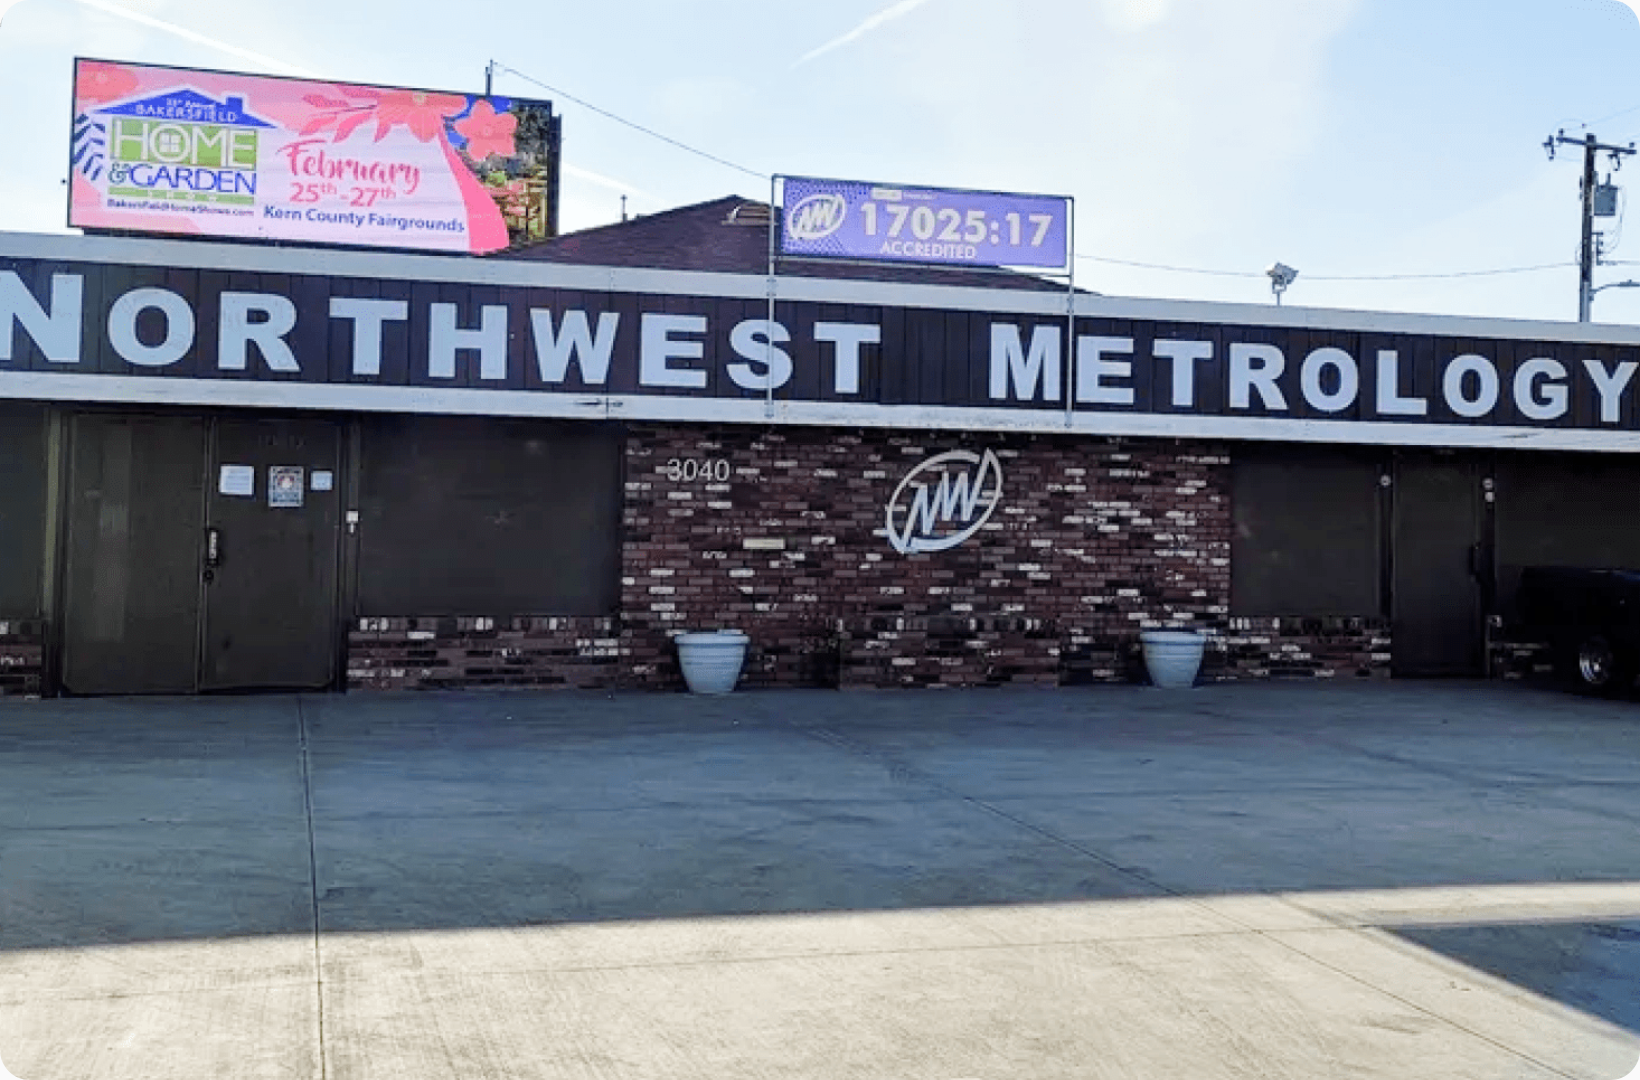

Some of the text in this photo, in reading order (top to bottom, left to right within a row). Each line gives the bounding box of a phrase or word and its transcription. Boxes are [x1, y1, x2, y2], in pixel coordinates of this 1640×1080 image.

[115, 119, 254, 170] HOME
[277, 139, 420, 195] February
[263, 204, 466, 234] Kern County Fairgrounds
[860, 201, 1054, 247] 17025:17
[880, 241, 977, 259] ACCREDITED
[0, 268, 1639, 423] NORTHWEST METROLOGY
[666, 458, 731, 483] 3040
